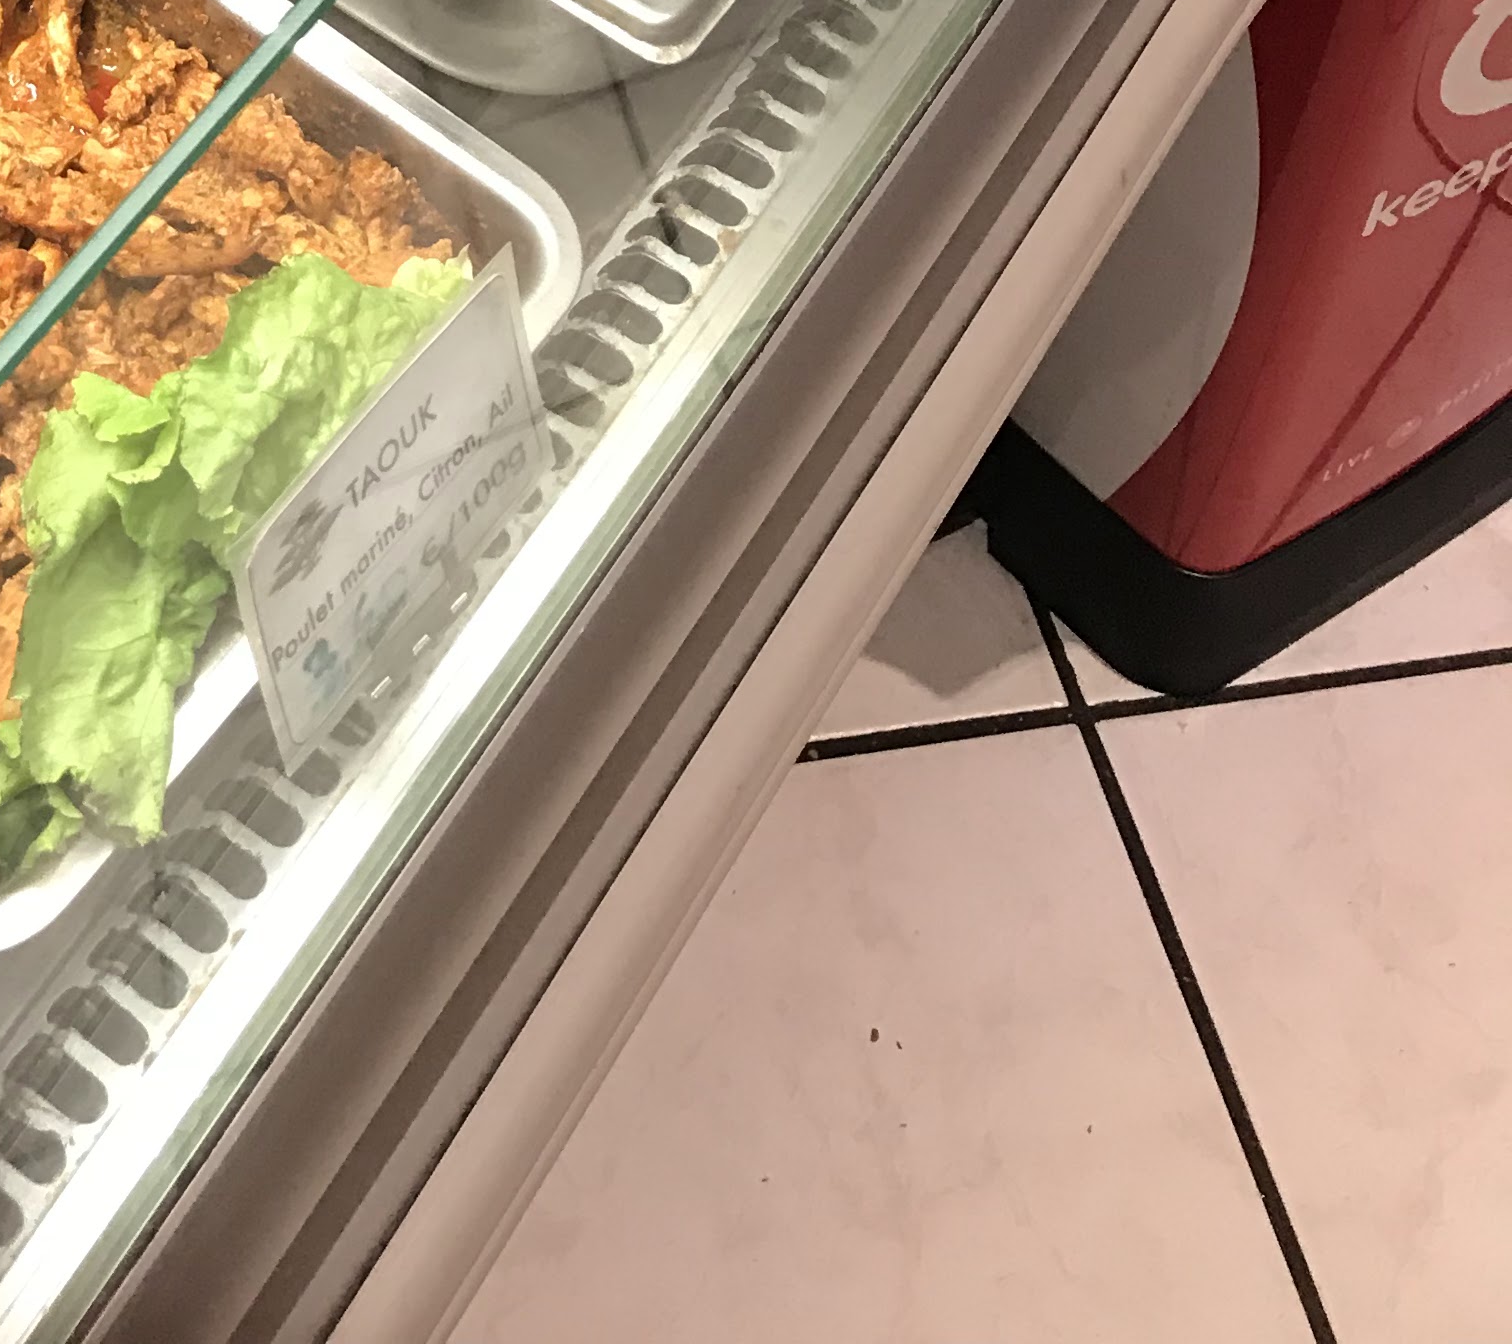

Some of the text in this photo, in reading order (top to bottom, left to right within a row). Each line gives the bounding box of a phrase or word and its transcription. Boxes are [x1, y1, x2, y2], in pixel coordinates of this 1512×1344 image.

[270, 591, 336, 674] Poulet
[340, 503, 414, 593] mariné,
[417, 433, 484, 502] Citron,
[488, 383, 516, 434] Ail
[344, 393, 439, 510] TAOUK
